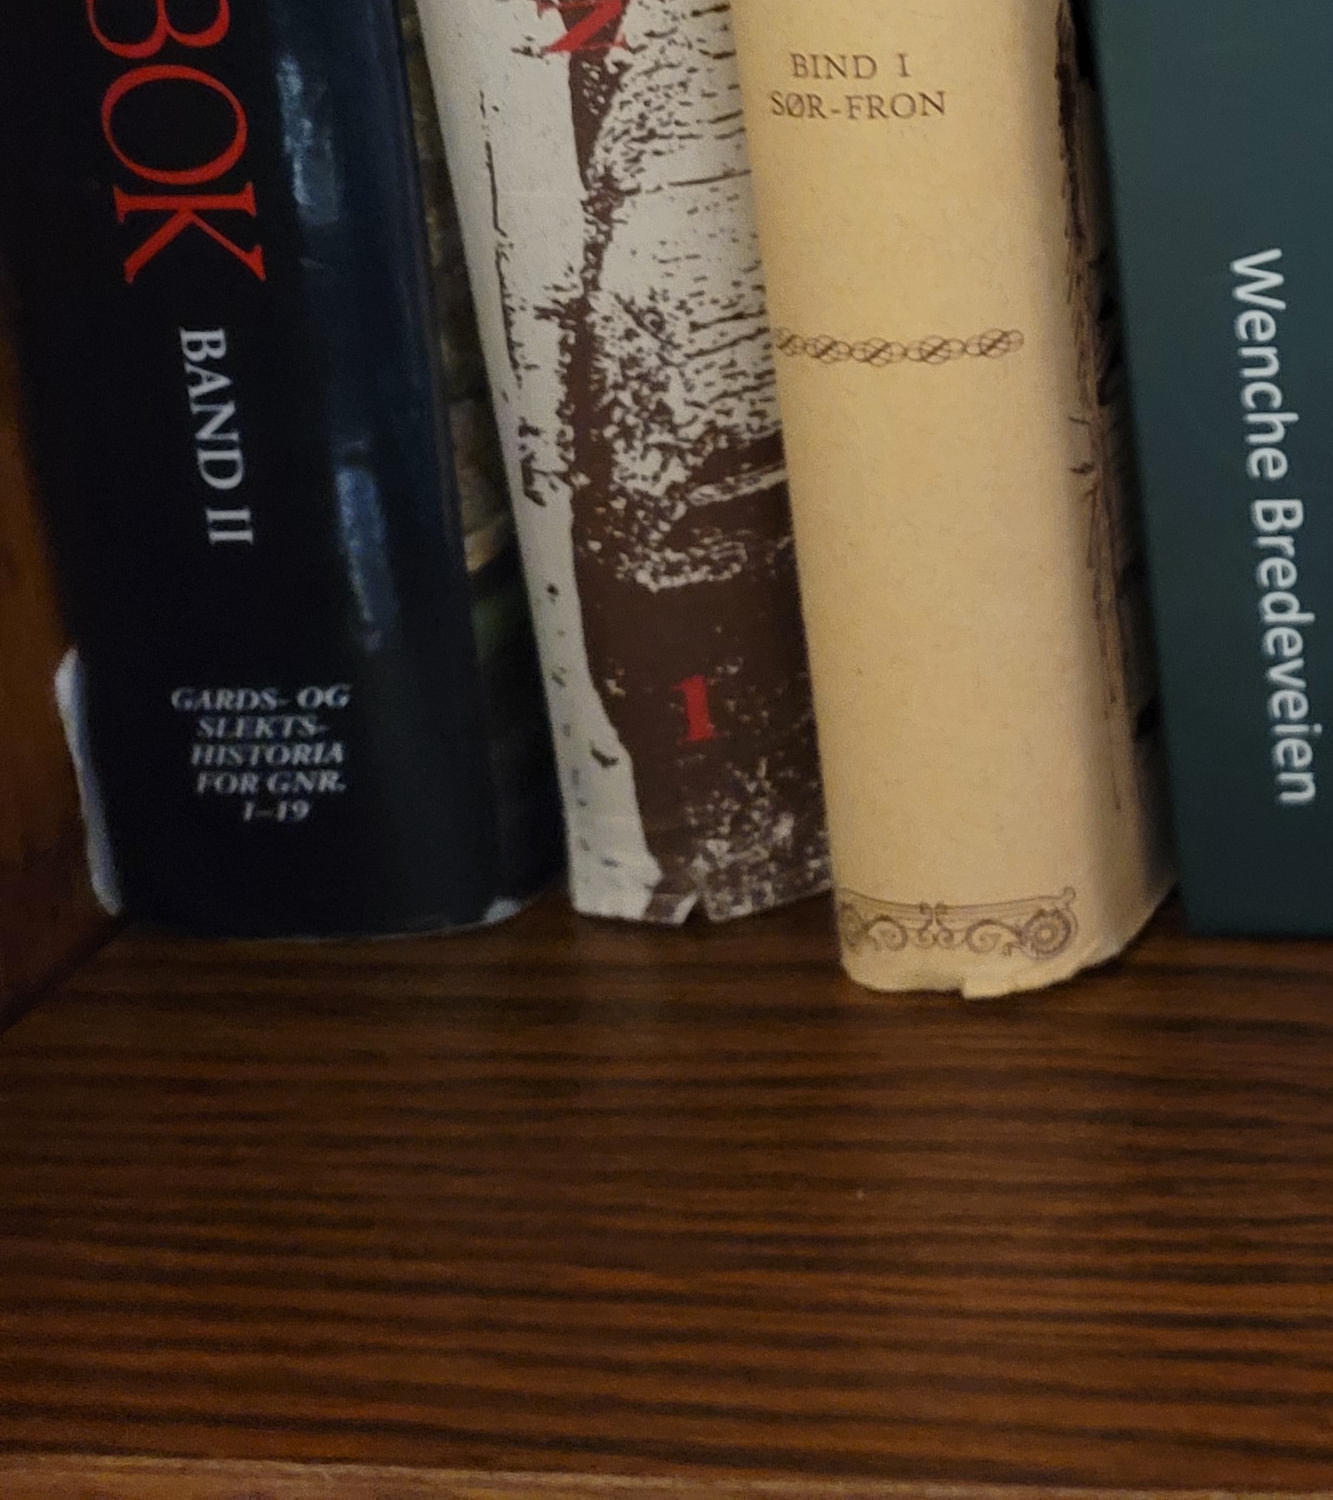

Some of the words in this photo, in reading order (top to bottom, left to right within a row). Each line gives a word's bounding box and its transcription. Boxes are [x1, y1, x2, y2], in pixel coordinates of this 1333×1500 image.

[789, 51, 878, 80] BIND
[897, 52, 912, 78] I
[770, 90, 946, 122] SØR-FRON
[1230, 248, 1300, 482] Wenche
[178, 326, 245, 491] BAND
[205, 507, 254, 546] II
[1251, 498, 1323, 805] Bredeveien
[171, 687, 290, 712] GARDS-
[296, 683, 352, 710] OG
[190, 741, 344, 767] HISTORIA
[197, 771, 259, 795] FOR
[267, 769, 347, 794] GNR.
